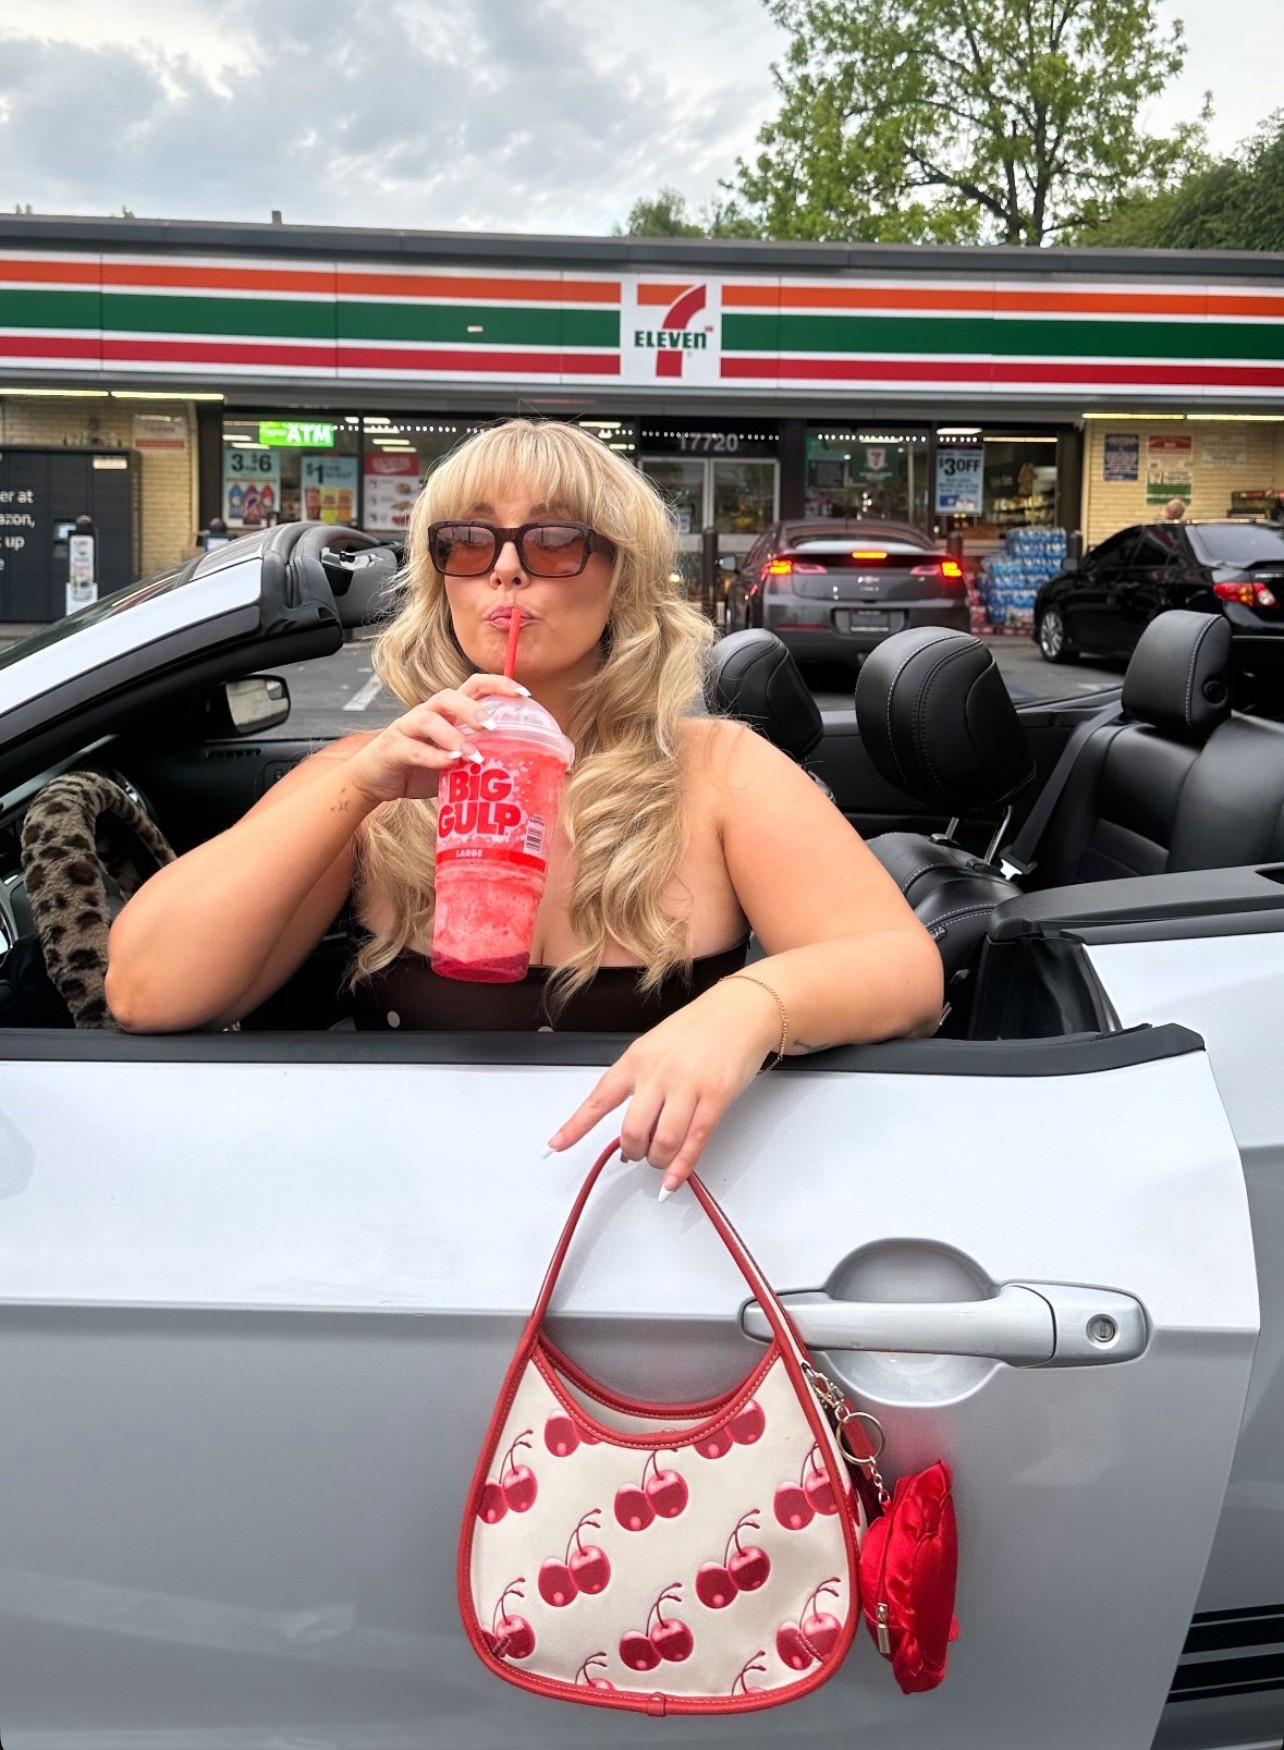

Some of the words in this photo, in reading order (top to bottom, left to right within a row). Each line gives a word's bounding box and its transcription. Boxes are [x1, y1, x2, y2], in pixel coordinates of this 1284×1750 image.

[286, 424, 332, 444] ATM
[681, 432, 738, 452] 17720
[232, 453, 243, 471] 3
[956, 458, 981, 472] OFF
[17, 490, 34, 503] at
[5, 536, 25, 551] up
[438, 802, 521, 838] GULP
[456, 849, 482, 858] LARGE
